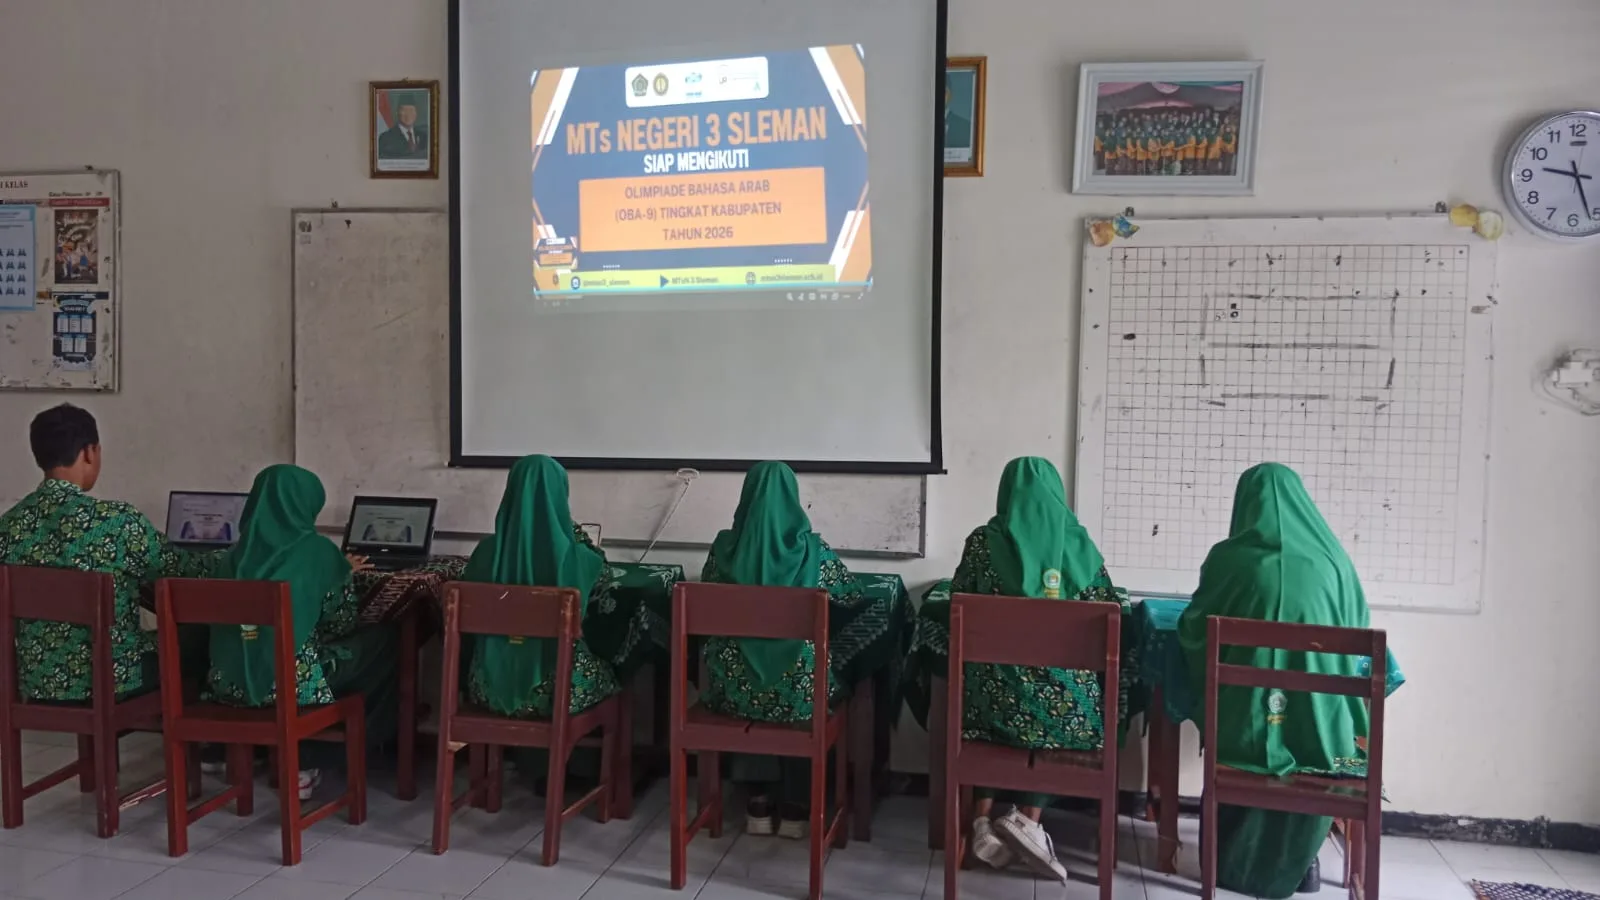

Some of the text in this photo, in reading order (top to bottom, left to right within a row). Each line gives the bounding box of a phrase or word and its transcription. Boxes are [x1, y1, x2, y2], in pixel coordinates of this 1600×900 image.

[566, 106, 827, 155] MTs NEGERI 3 SLEMAN
[1548, 130, 1561, 143] 11
[1569, 124, 1587, 137] 12
[643, 148, 749, 174] SIAP MENGIKUTI
[1530, 147, 1548, 161] 10
[1521, 168, 1533, 182] 9
[624, 179, 770, 200] OLIMPIADE BAHASA ARAB
[1527, 190, 1539, 204] 8
[615, 202, 782, 222] (OBA-9) TINGKAT KABUPATEN
[1546, 207, 1557, 220] 7
[1592, 207, 1600, 221] 5
[1567, 213, 1579, 227] 6
[663, 226, 734, 241] TAHUN 2026
